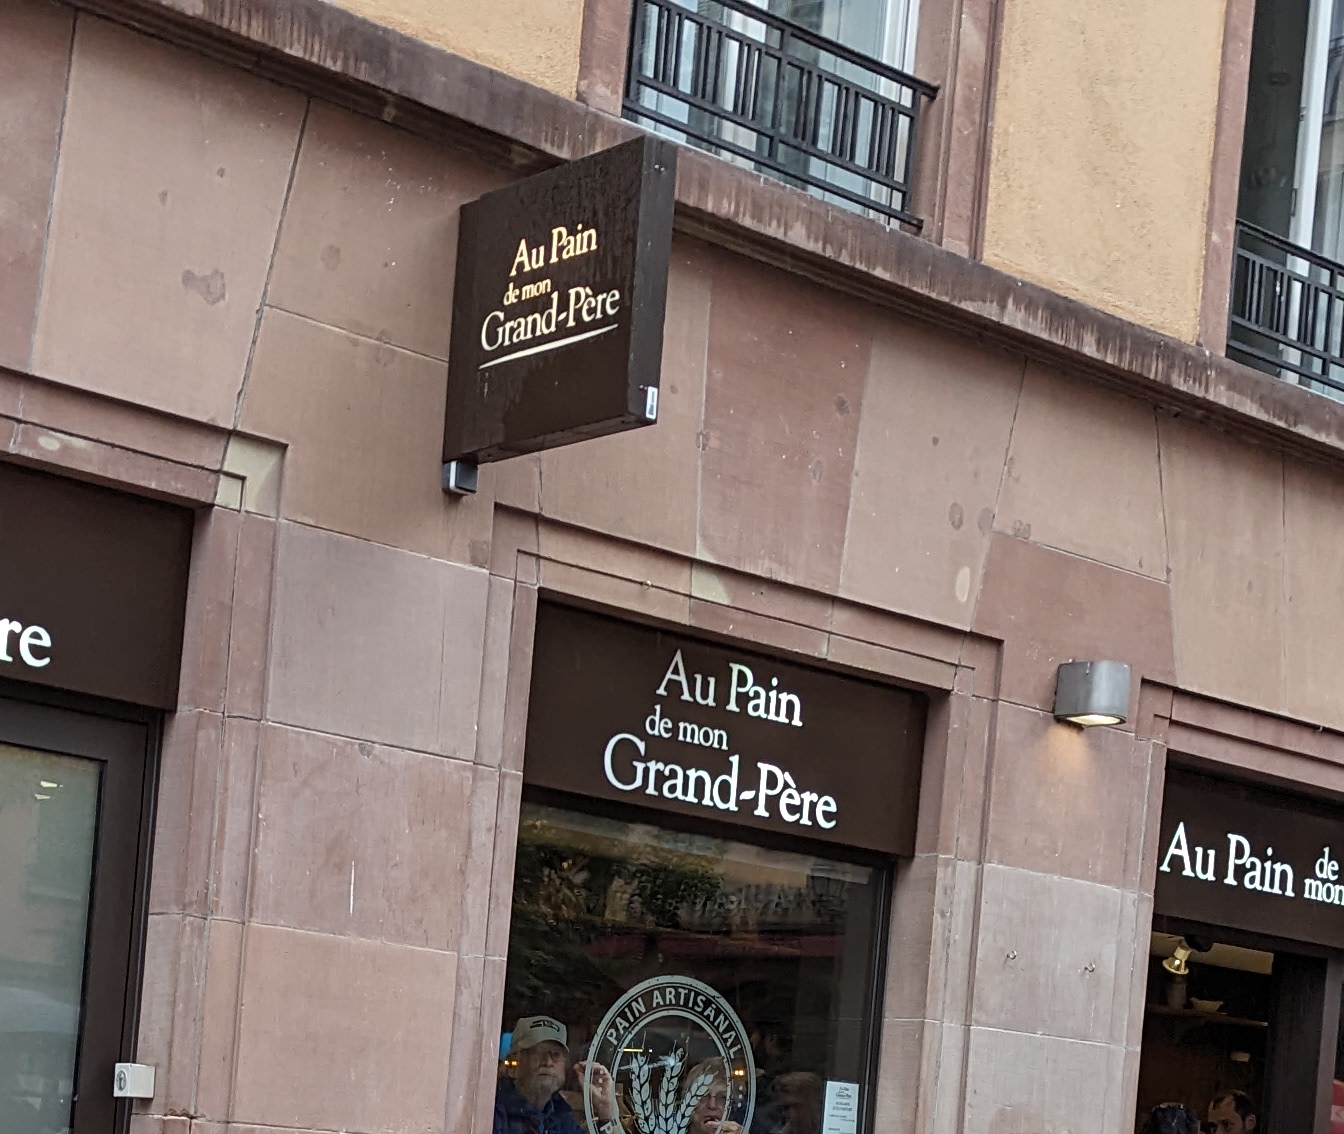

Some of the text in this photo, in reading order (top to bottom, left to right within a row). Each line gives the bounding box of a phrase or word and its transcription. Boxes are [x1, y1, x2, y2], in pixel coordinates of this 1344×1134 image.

[509, 223, 598, 277] Au Pain
[480, 285, 621, 351] Grand-Père
[503, 277, 552, 307] de mon
[656, 648, 803, 727] Au Pain
[645, 704, 729, 751] de mon
[603, 732, 838, 830] Grand-Père
[1159, 821, 1295, 898] Au Pain
[1315, 847, 1339, 881] de
[606, 986, 742, 1060] PAIN ARTISANAL
